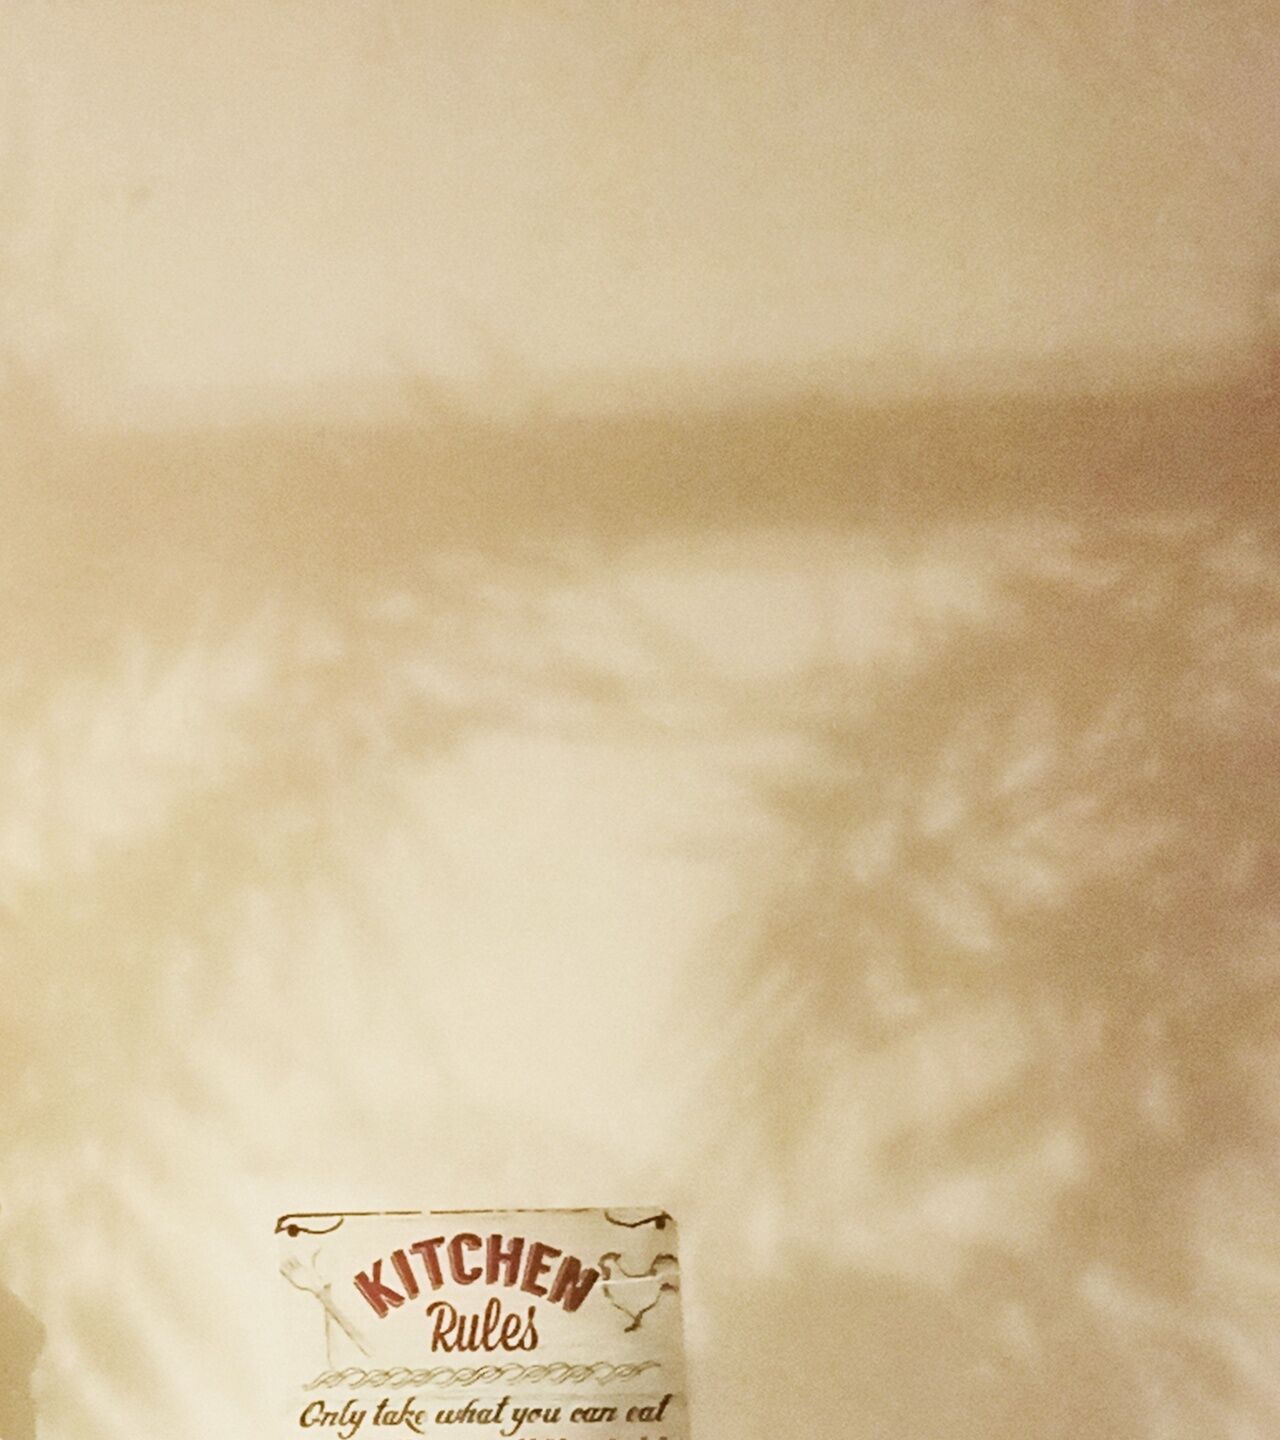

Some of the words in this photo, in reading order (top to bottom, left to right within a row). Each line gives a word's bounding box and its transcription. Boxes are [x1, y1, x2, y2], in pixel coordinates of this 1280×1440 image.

[353, 1232, 601, 1319] KITCHEN
[426, 1297, 539, 1353] Rules
[299, 1399, 365, 1440] Only
[372, 1396, 426, 1435] take
[435, 1395, 510, 1427] what
[500, 1404, 561, 1437] you
[570, 1405, 618, 1424] can
[626, 1394, 673, 1424] eat
